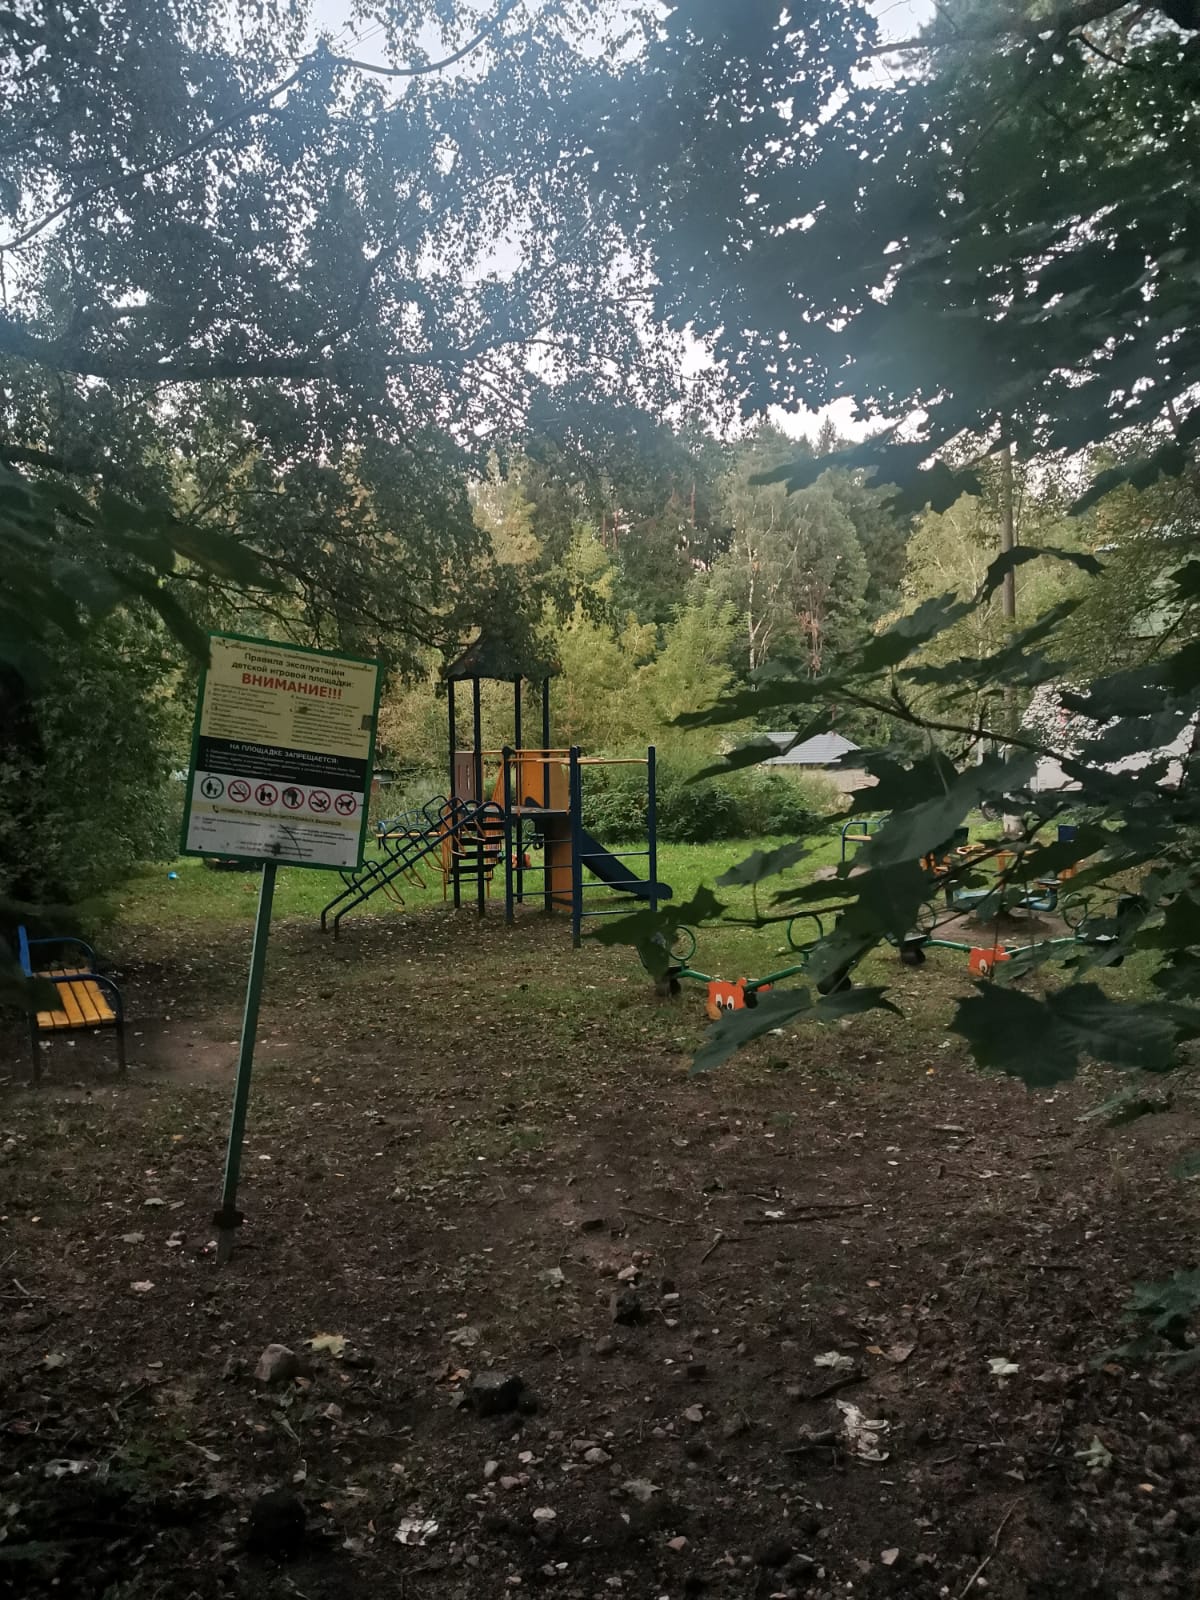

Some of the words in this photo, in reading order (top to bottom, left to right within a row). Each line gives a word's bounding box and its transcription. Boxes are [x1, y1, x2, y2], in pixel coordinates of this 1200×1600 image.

[232, 661, 268, 674] детской
[270, 667, 306, 681] игровой
[244, 652, 284, 667] Правила
[285, 660, 345, 678] эксплуатации
[241, 672, 342, 700] ВНИМАНИЕ!!!
[229, 743, 240, 751] НА
[241, 744, 283, 757] ПЛОЩАДКЕ
